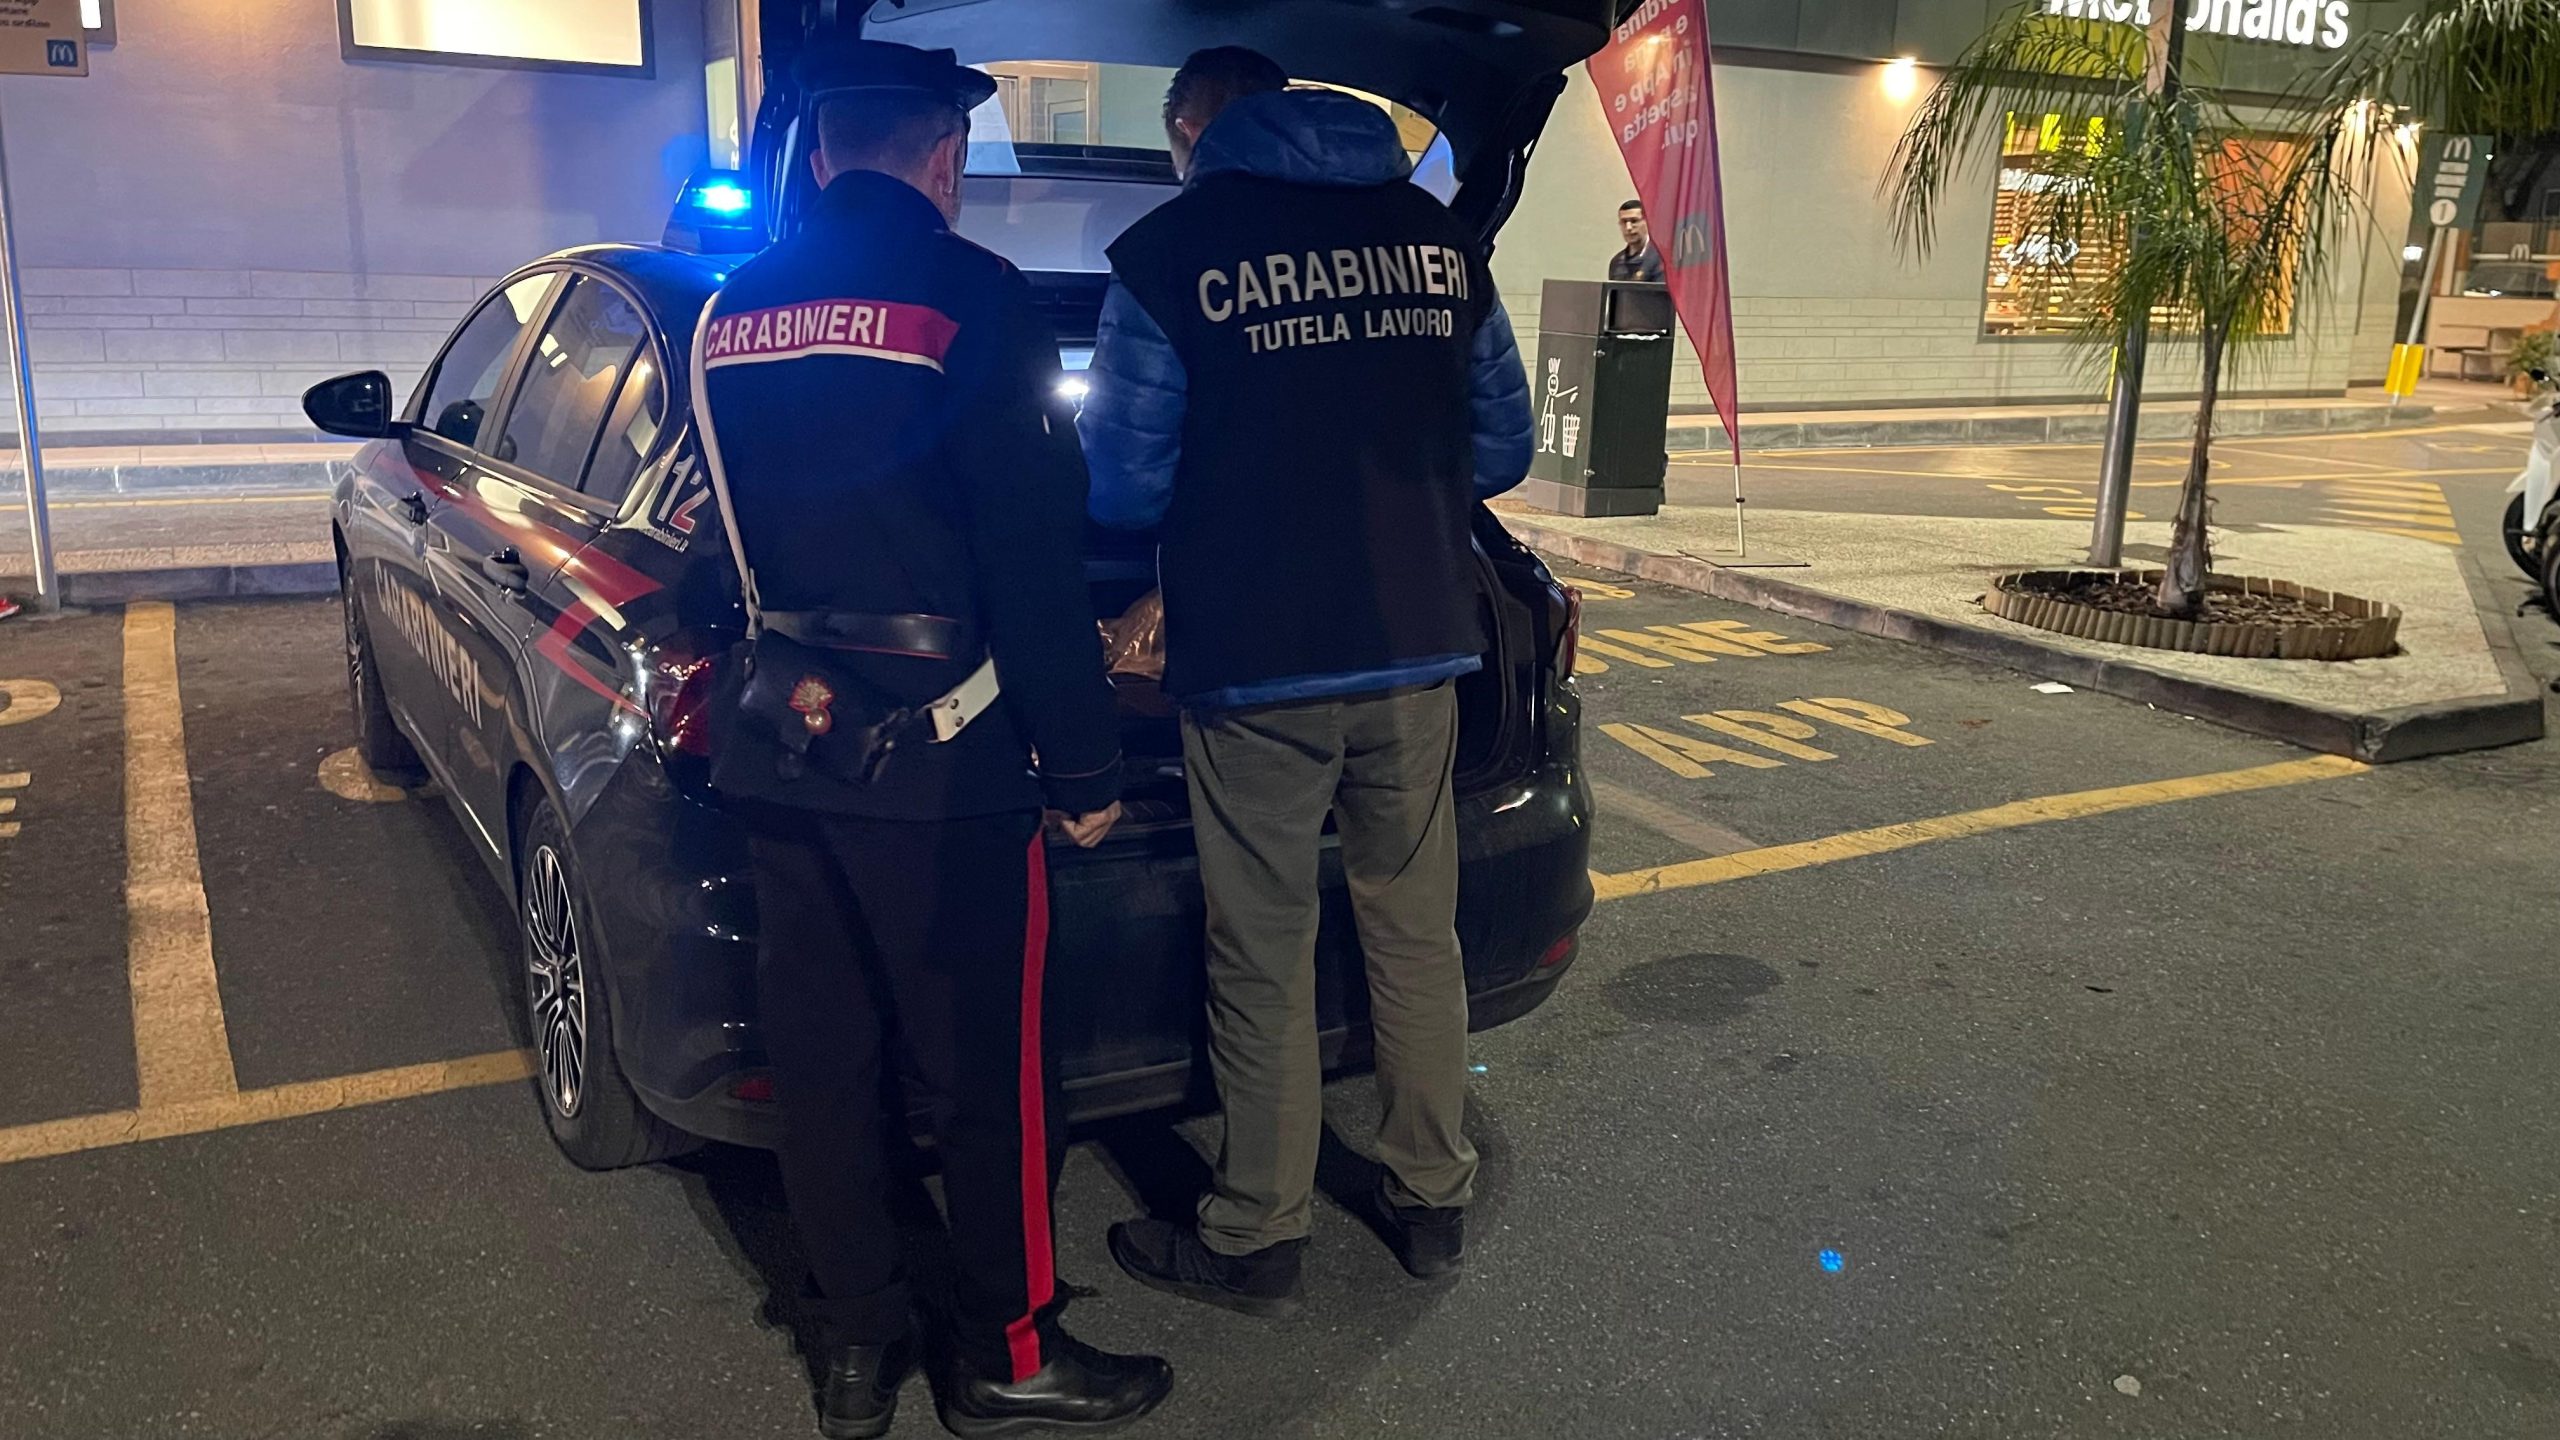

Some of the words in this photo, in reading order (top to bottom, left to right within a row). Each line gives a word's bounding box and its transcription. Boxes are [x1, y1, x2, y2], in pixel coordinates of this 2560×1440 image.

[1199, 245, 1468, 322] CARABINIERI
[706, 304, 888, 358] CARABINIERI
[1244, 312, 1352, 353] TUTELA
[1364, 308, 1453, 338] LAVORO
[375, 558, 482, 730] CARABINIERI
[1598, 697, 1937, 779] APP
